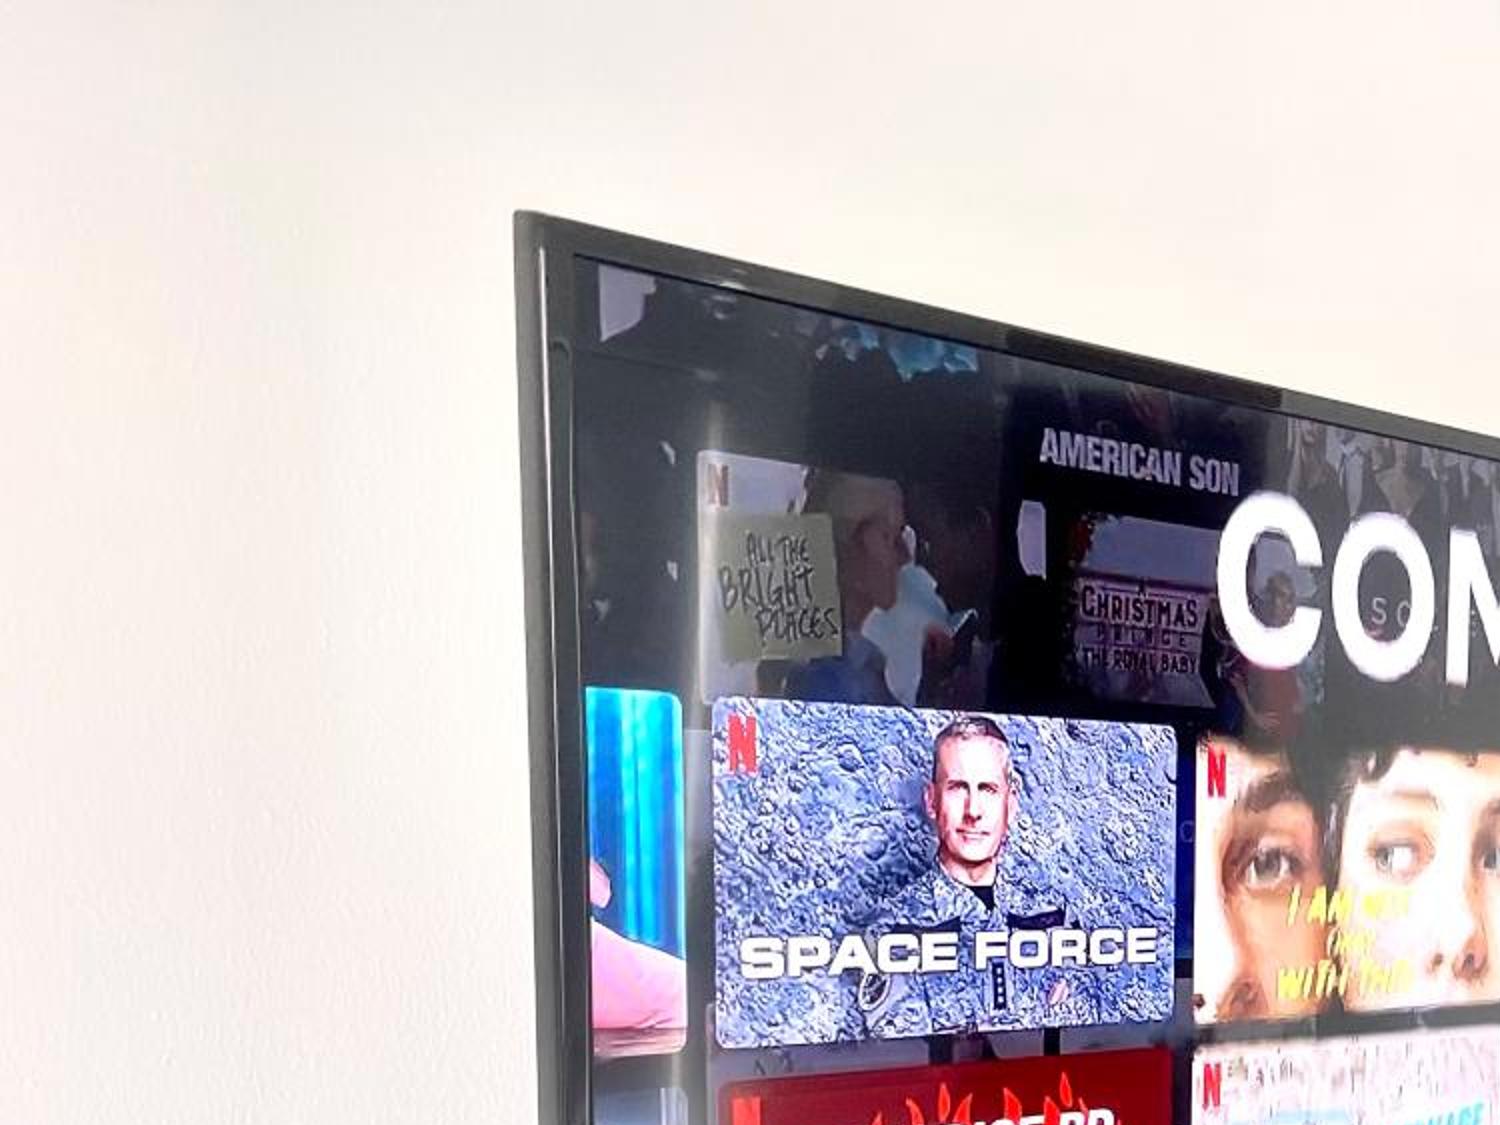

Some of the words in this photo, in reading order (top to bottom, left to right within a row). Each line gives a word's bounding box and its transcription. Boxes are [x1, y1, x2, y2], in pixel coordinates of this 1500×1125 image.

[1040, 427, 1183, 487] AMERICAN
[1188, 453, 1241, 498] SON
[745, 531, 774, 567] ALL
[774, 535, 809, 567] THE
[719, 564, 814, 613] BRIGHT
[1081, 584, 1199, 628] CHRISTMAS
[754, 608, 838, 648] PLACES
[1160, 653, 1197, 674] BABY
[727, 716, 757, 775] N
[1207, 750, 1227, 798] N
[739, 931, 959, 981] SPACE
[974, 927, 1158, 971] FORCE
[1202, 1062, 1221, 1110] N
